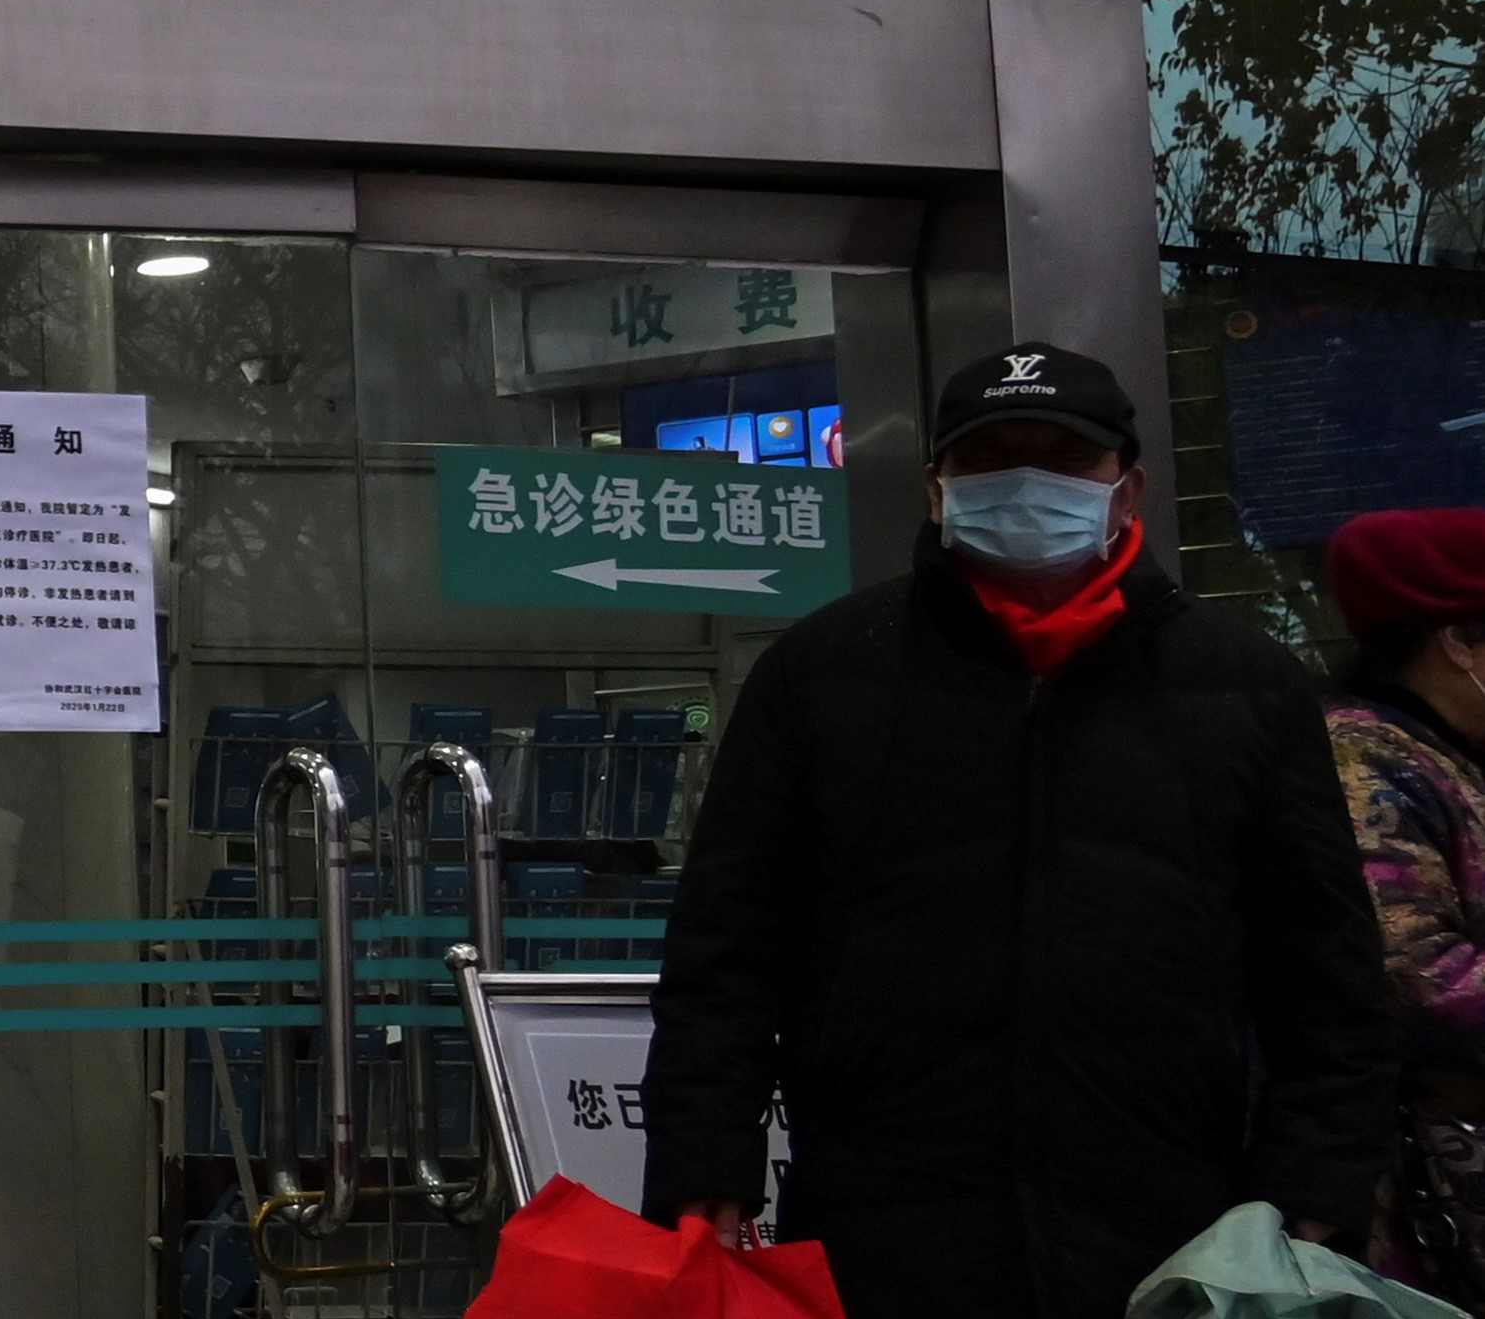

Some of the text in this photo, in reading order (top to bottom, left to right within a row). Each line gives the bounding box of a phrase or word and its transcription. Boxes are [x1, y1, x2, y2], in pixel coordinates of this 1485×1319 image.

[610, 269, 797, 347] 收费
[468, 467, 826, 550] 急诊绿色通道
